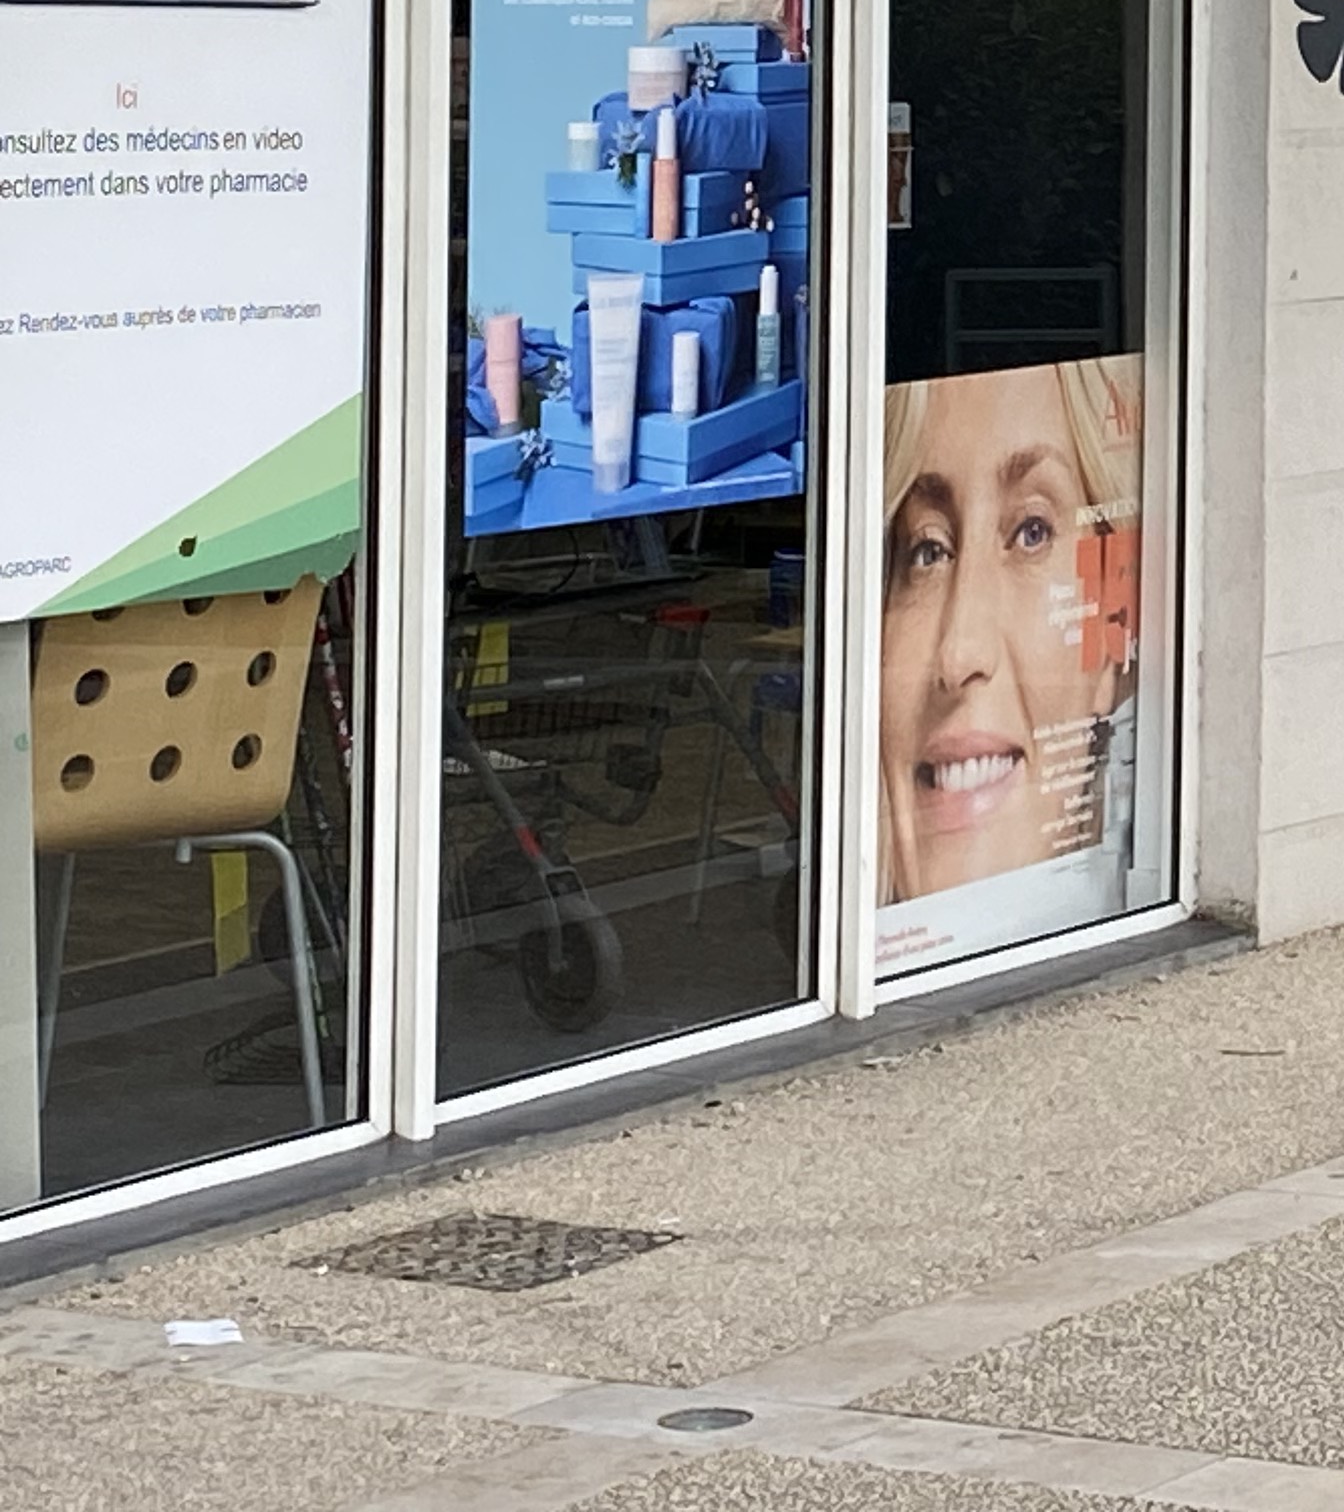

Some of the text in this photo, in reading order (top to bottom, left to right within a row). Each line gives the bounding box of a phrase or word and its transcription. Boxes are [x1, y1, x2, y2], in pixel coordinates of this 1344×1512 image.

[116, 82, 138, 110] Ici
[83, 127, 120, 154] des
[126, 126, 219, 153] médecins
[222, 132, 247, 152] en
[100, 170, 150, 197] dans
[156, 170, 204, 196] votre
[210, 168, 308, 199] pharmacie
[18, 312, 118, 334] Rendez-vous
[122, 305, 174, 330] auprès
[177, 304, 197, 324] de
[200, 304, 237, 323] votre
[240, 301, 322, 325] pharmacien
